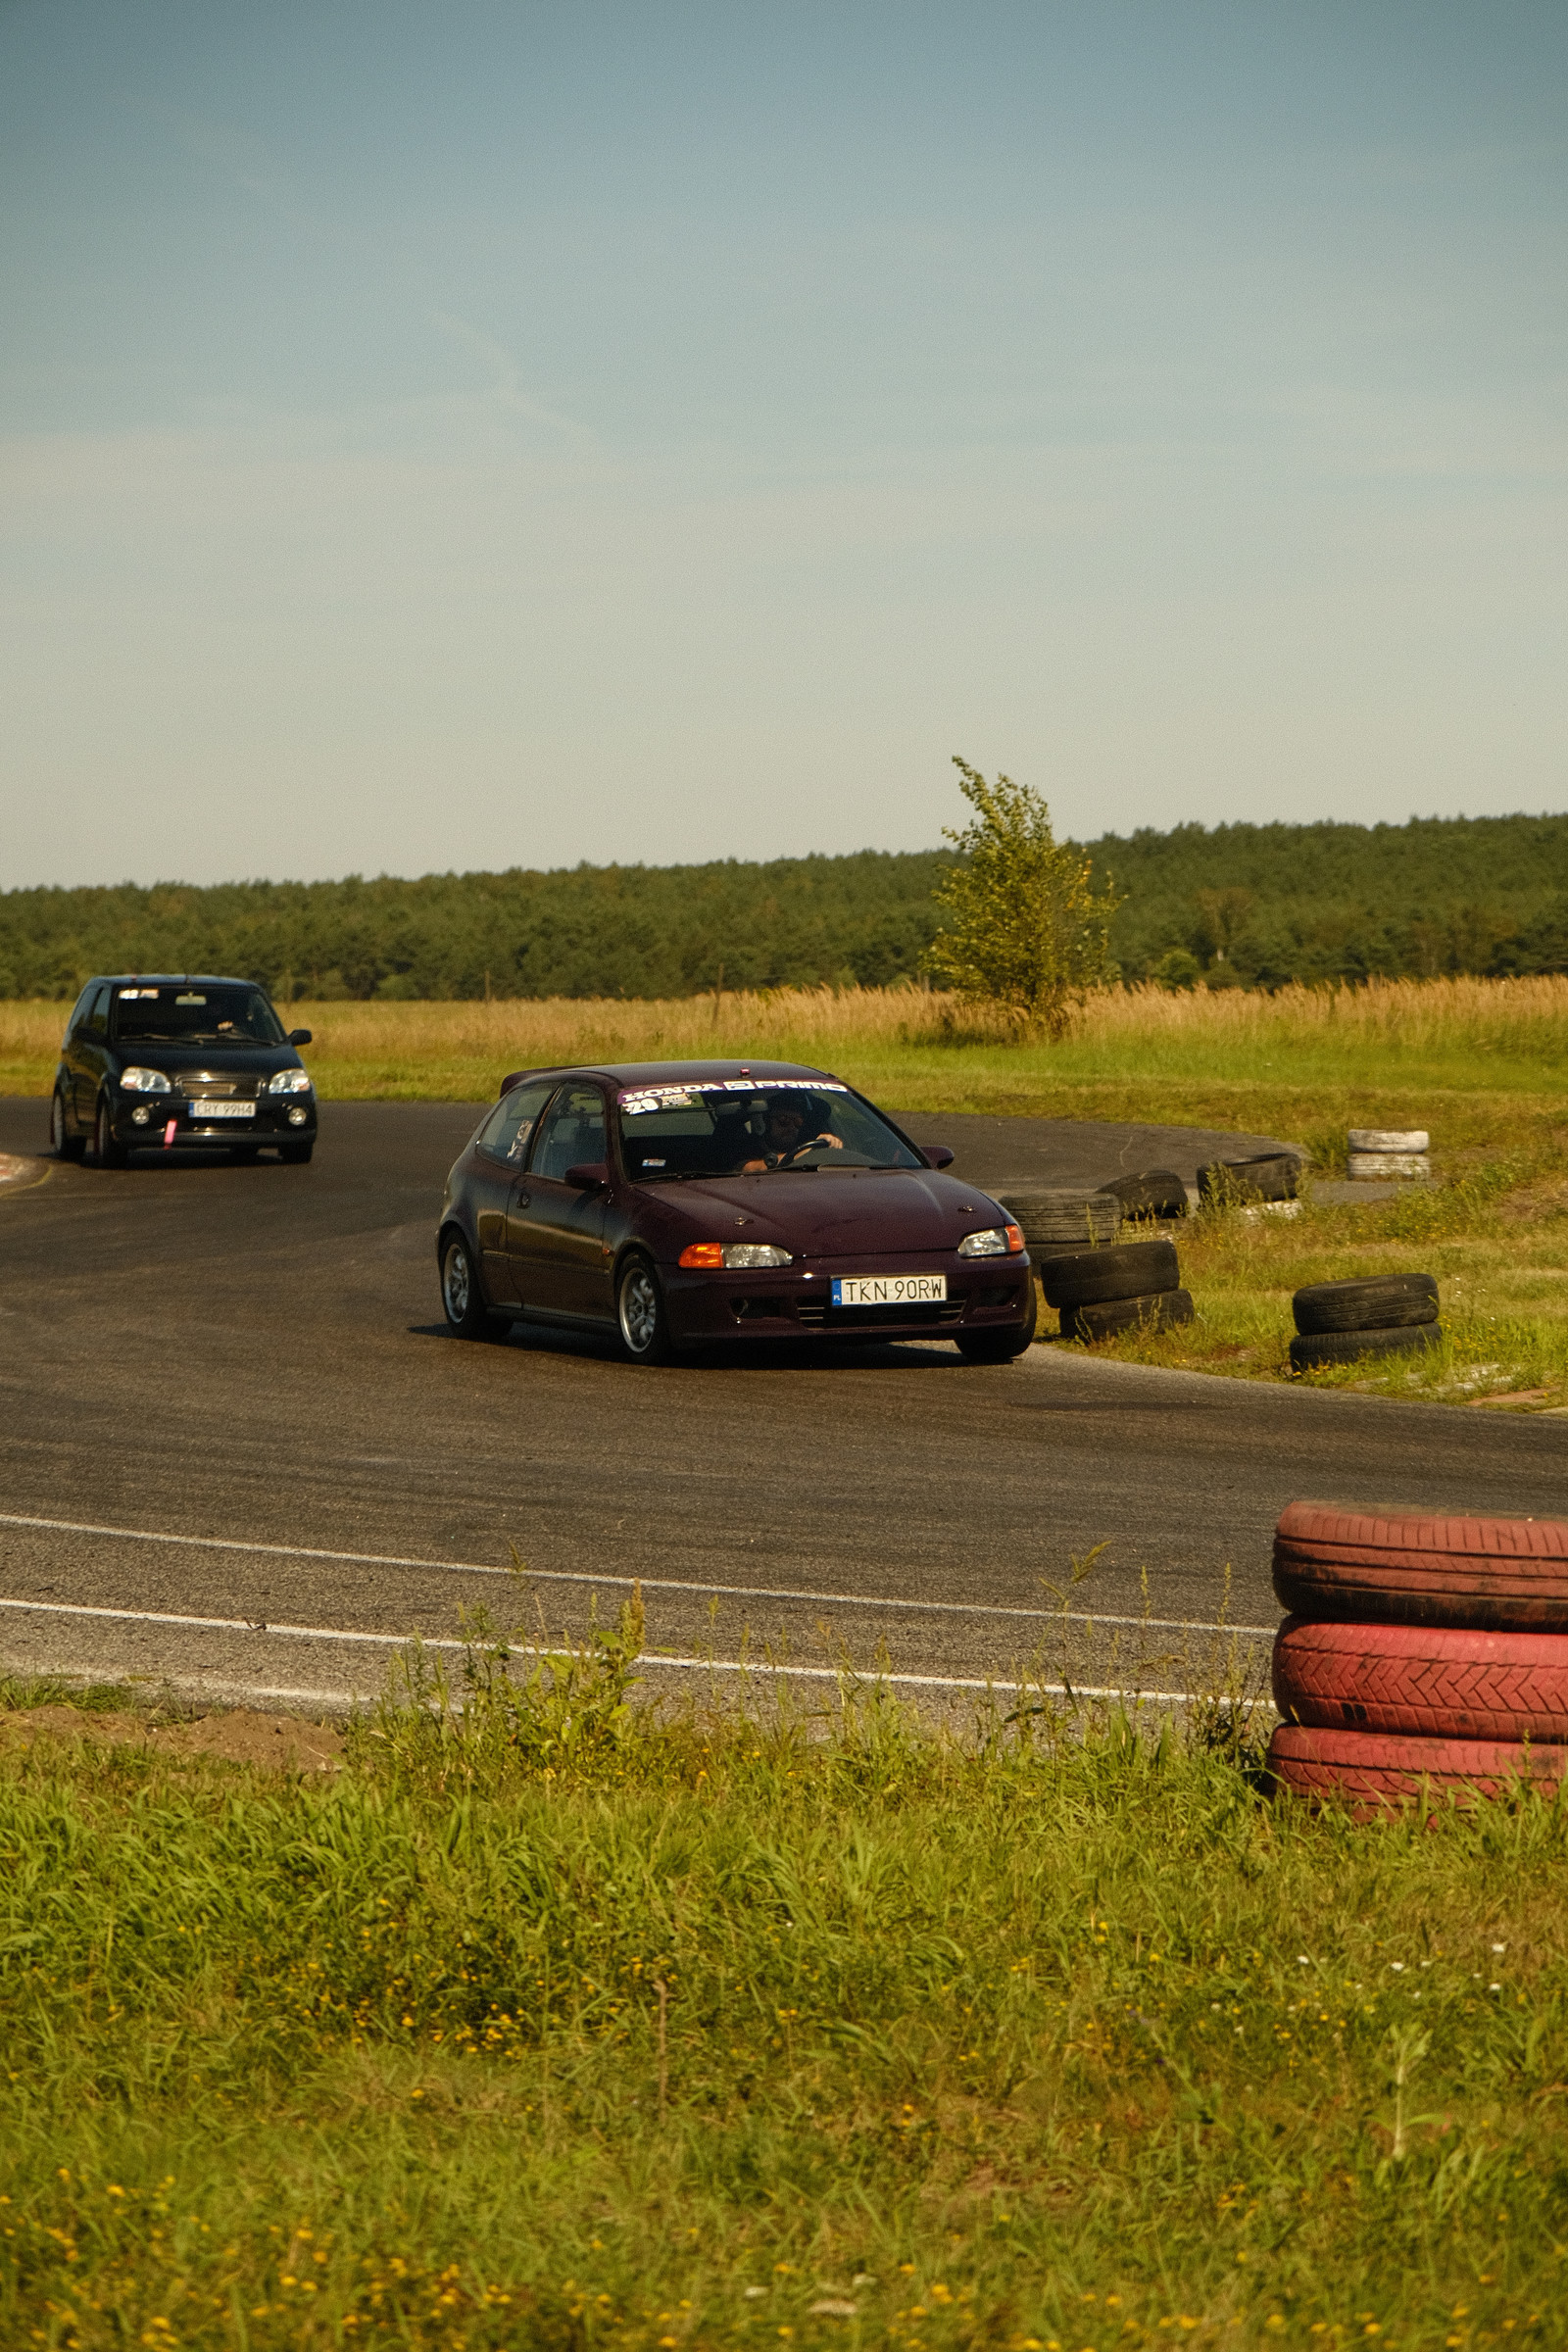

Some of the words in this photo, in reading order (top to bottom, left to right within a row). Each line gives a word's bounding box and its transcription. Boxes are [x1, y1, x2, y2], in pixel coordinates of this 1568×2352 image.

[622, 1083, 722, 1102] HONDA
[754, 1080, 848, 1093] PRIMO
[622, 1099, 659, 1115] 29
[846, 1281, 887, 1301] TKN
[895, 1279, 942, 1300] 90RW
